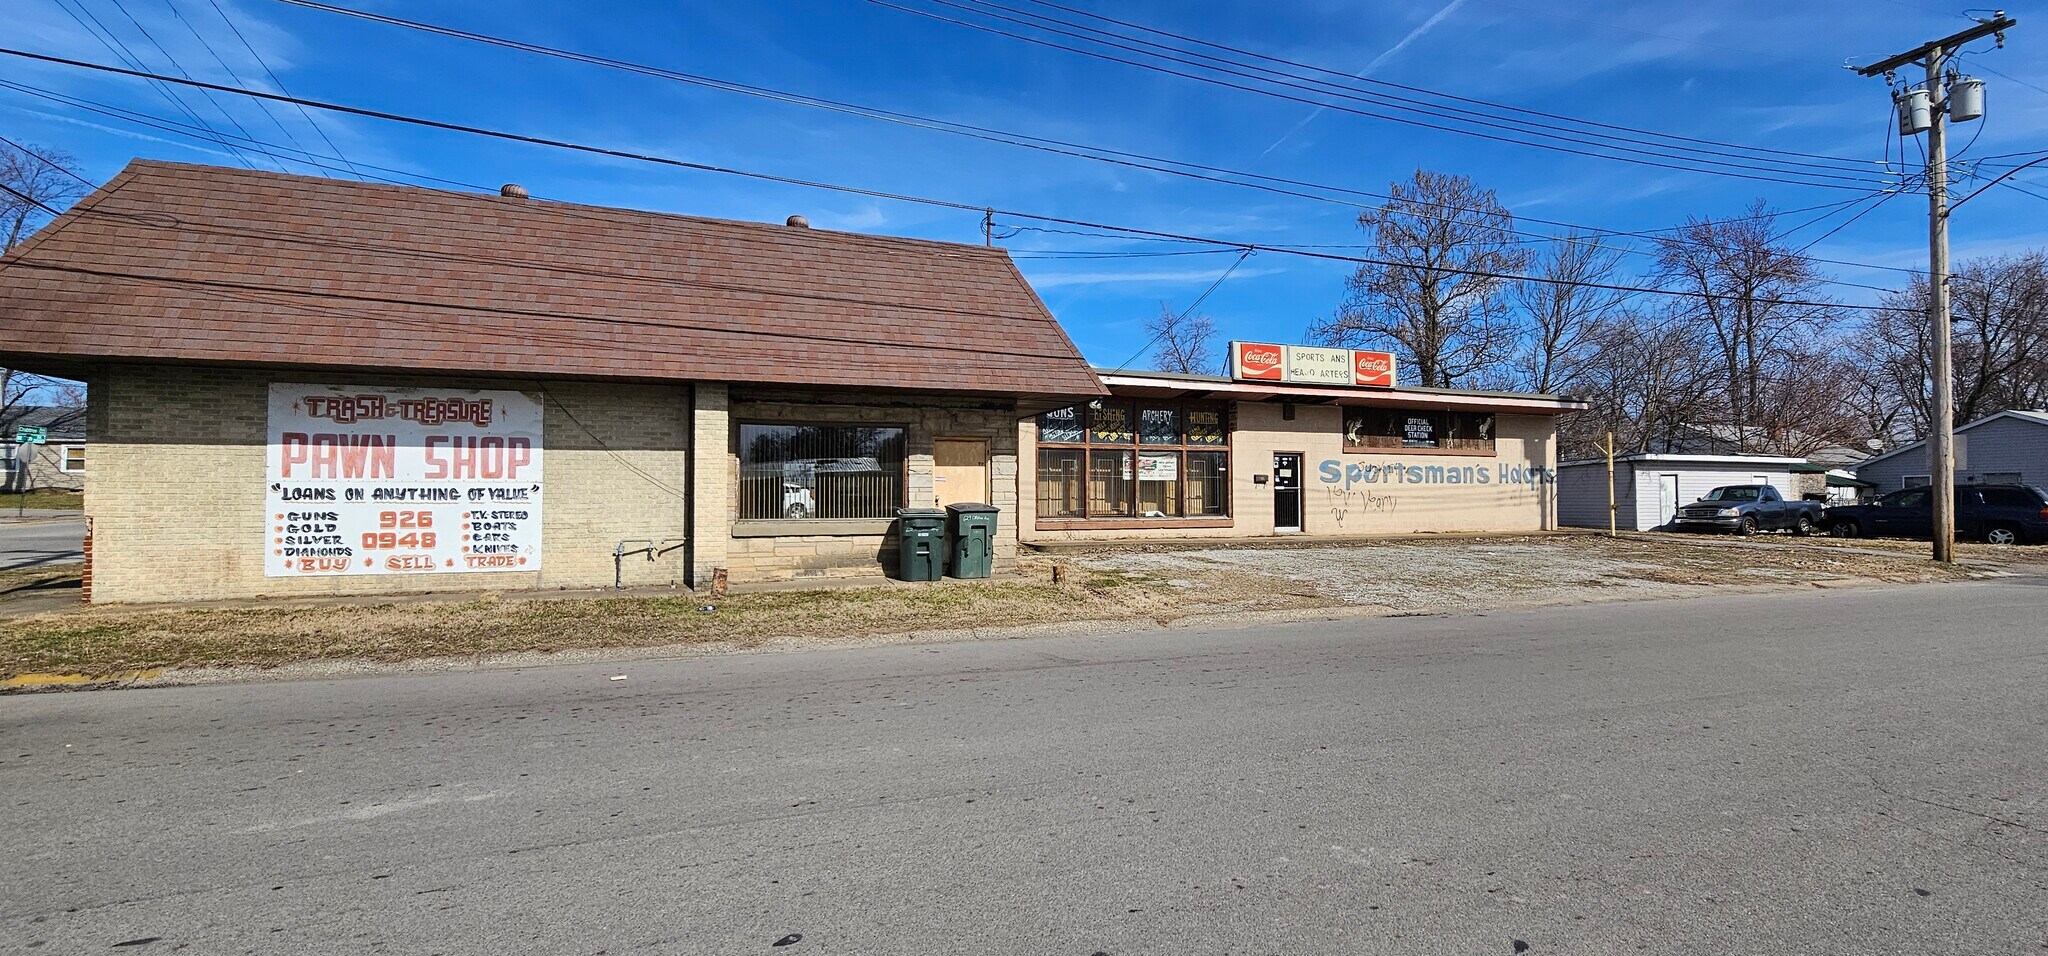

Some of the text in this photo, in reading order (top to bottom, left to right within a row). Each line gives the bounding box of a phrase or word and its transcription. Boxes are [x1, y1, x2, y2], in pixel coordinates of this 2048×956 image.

[1296, 352, 1346, 363] SPORTS ANS
[304, 394, 387, 424] TRASH
[398, 396, 493, 427] TREASURE
[1142, 409, 1173, 424] ARCHERY
[1407, 417, 1430, 426] OFFICIAL
[1404, 424, 1417, 432] DEER
[1407, 431, 1429, 439] STATION
[282, 432, 531, 480] PAWN SHOP
[1319, 460, 1490, 491] Sportsman's
[345, 487, 365, 501] ON
[371, 487, 461, 501] ANYTHING
[467, 488, 486, 501] OF
[287, 511, 340, 521] GUNS
[380, 511, 433, 529] 926
[286, 523, 337, 534] GOLD
[471, 522, 517, 532] BOATS
[285, 535, 344, 546] SILVER
[362, 532, 437, 549] 0948
[472, 533, 511, 542] CARS
[284, 547, 353, 557] DIAMONDS
[472, 544, 519, 554] KNIVES
[300, 555, 515, 572] BUY SELL TRADE
